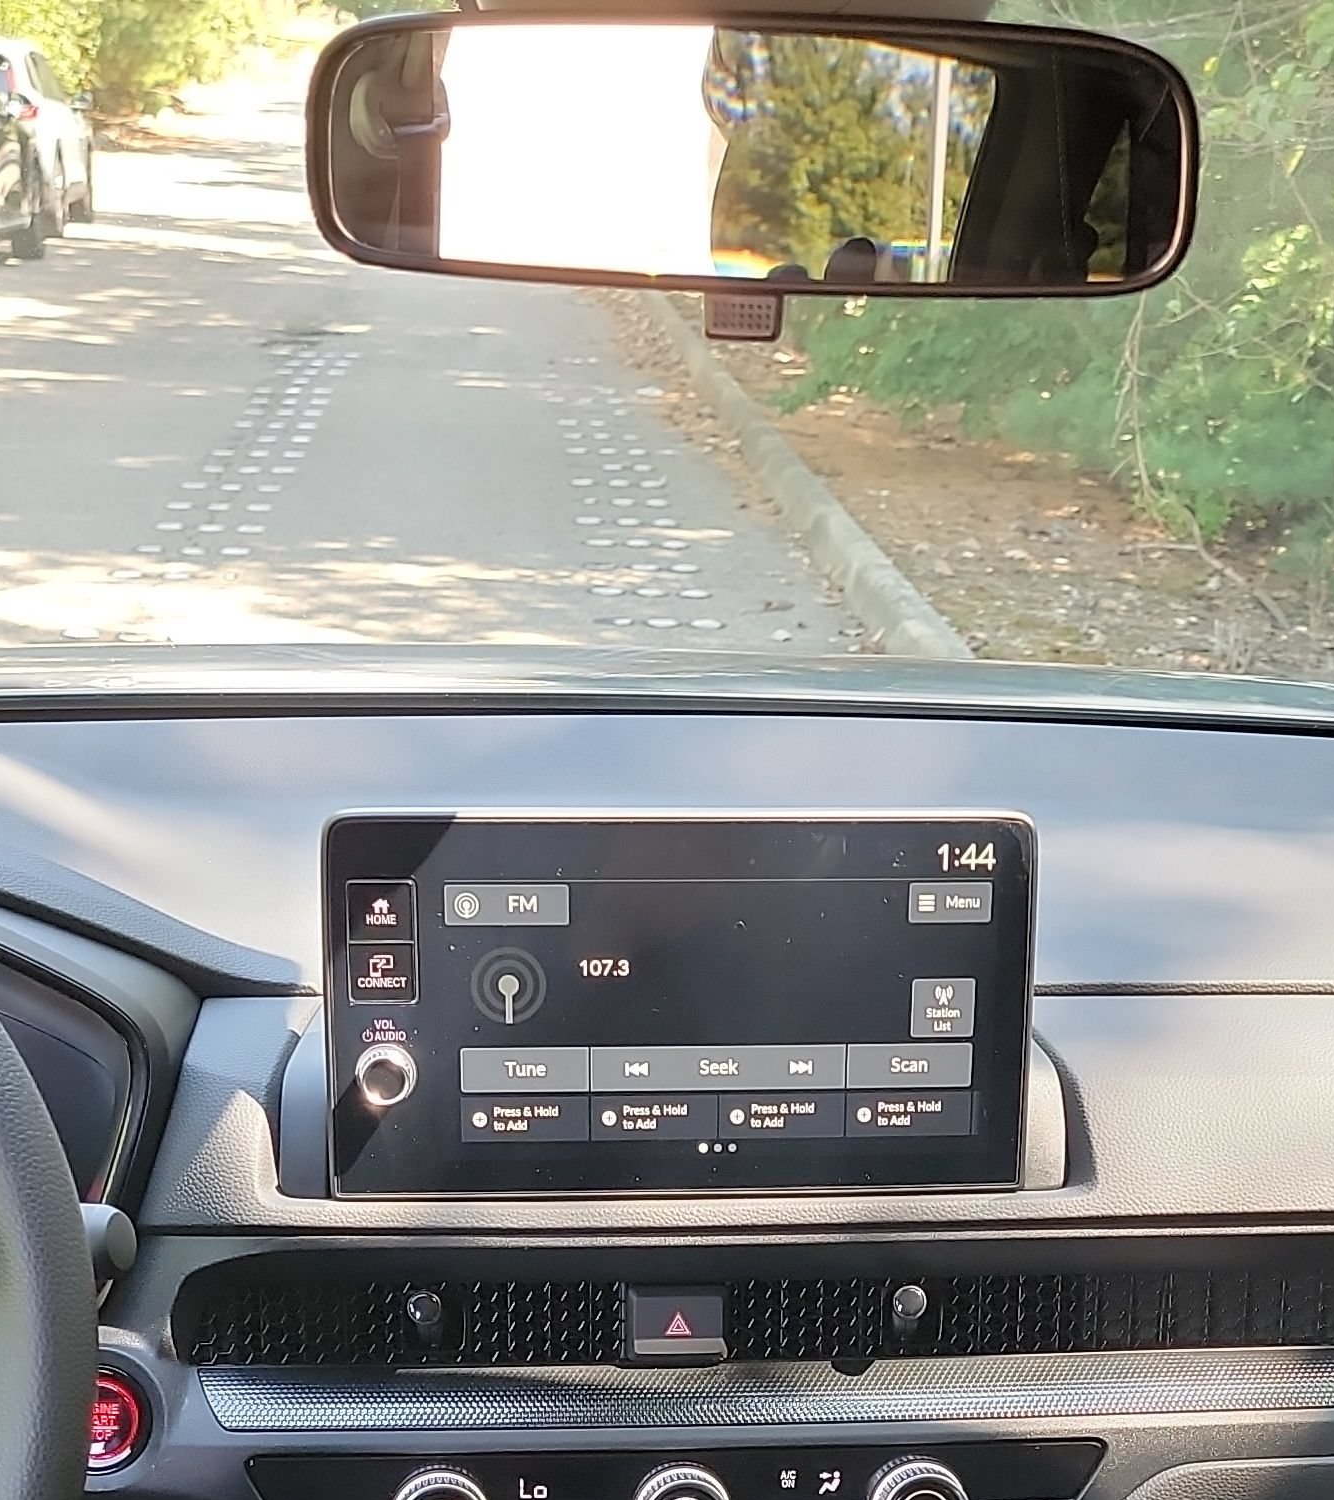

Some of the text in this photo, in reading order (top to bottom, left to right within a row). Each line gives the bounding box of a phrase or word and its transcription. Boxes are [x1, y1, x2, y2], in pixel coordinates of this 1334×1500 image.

[937, 843, 996, 872] 1:44
[508, 896, 537, 912] FM
[946, 895, 980, 909] Menu
[366, 914, 397, 925] HOME
[579, 960, 629, 977] 107.3
[357, 977, 407, 988] CONNECT
[926, 1007, 961, 1019] Station
[374, 1020, 395, 1029] VOL
[933, 1021, 951, 1031] List
[375, 1031, 407, 1041] AUDIO
[504, 1061, 547, 1077] Tune
[699, 1059, 739, 1075] Seek
[891, 1058, 928, 1073] Scan
[493, 1105, 559, 1118] Press & Hold
[623, 1104, 688, 1117] Press & Hold
[750, 1102, 815, 1115] Press & Hold
[877, 1100, 942, 1113] Press & Hold
[493, 1119, 528, 1131] to Add
[623, 1118, 657, 1130] to Add
[750, 1116, 785, 1128] to Add
[877, 1114, 911, 1126] to Add
[93, 1403, 120, 1414] GINE
[92, 1415, 116, 1426] ART
[91, 1430, 114, 1440] TOP
[780, 1471, 797, 1480] A/C
[519, 1478, 548, 1499] Lo
[781, 1480, 796, 1489] ON
